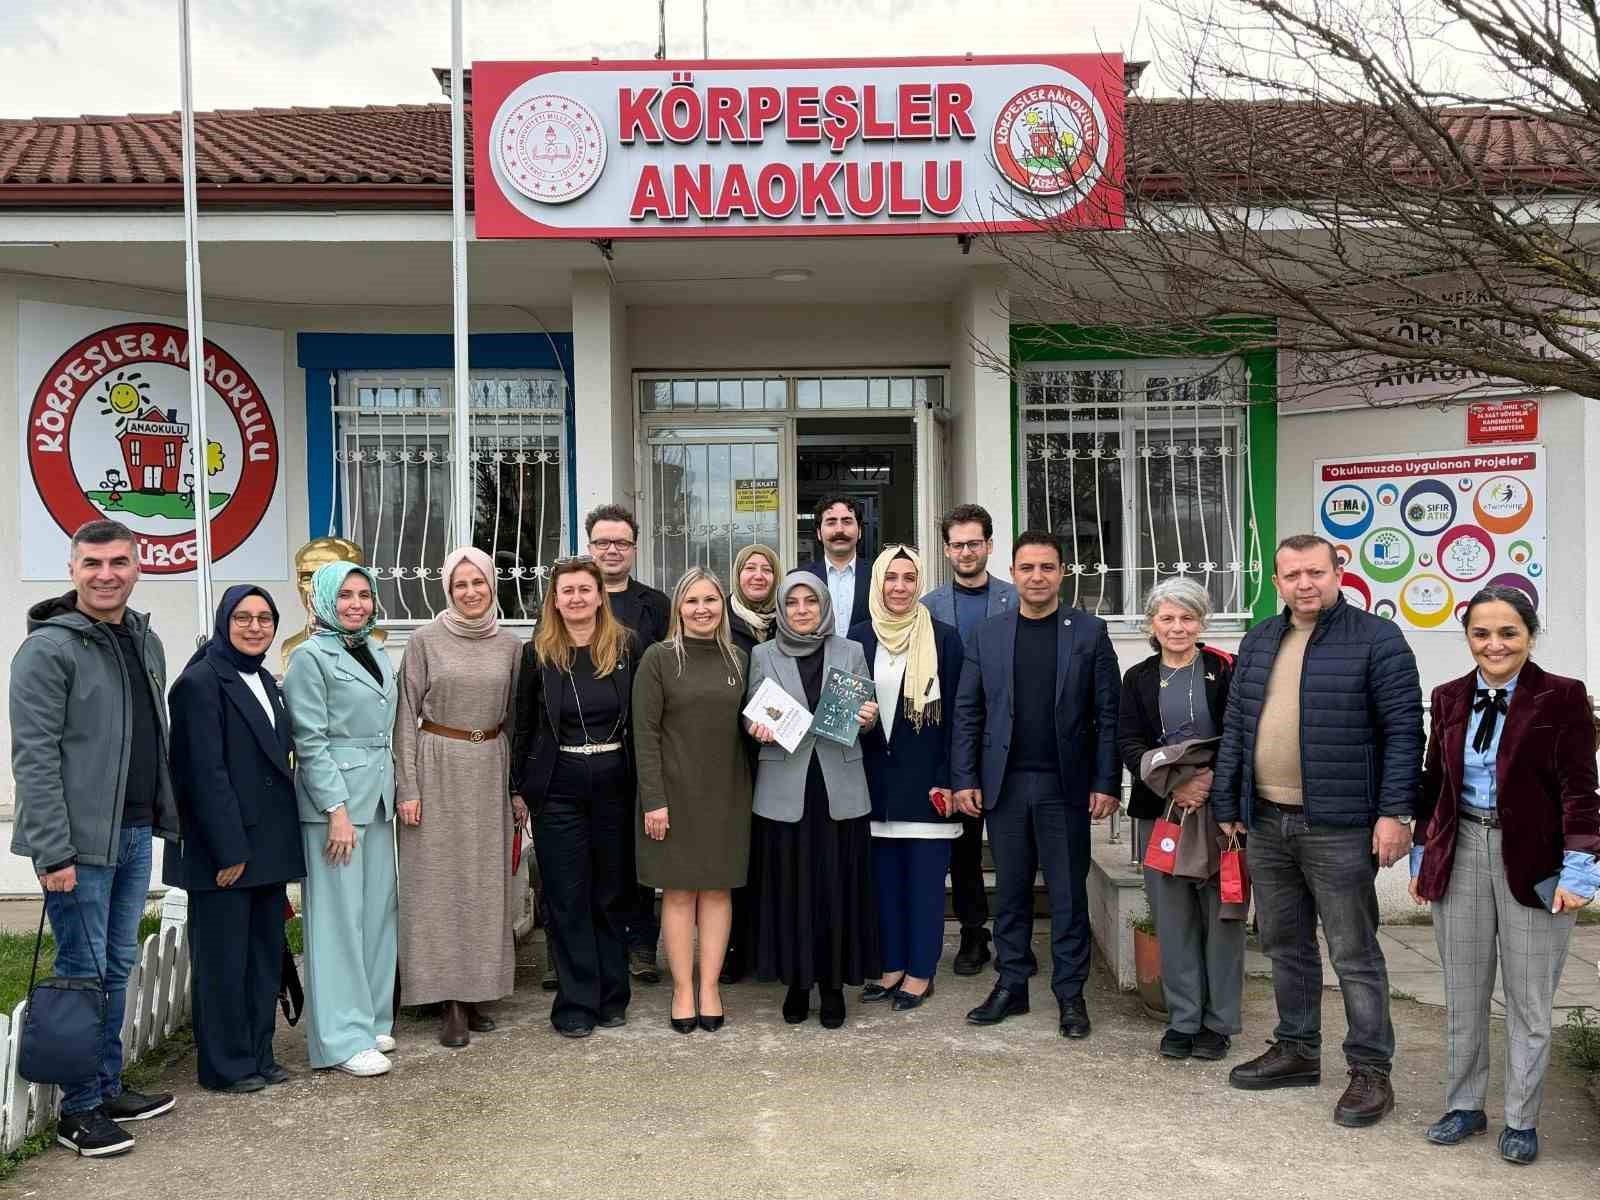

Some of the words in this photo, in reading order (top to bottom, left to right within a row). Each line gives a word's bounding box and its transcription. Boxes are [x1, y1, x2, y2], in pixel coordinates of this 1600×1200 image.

[617, 71, 976, 151] KÖRPEŞLER
[1047, 89, 1096, 140] ANAOKULU
[628, 160, 964, 220] ANAOKULU
[34, 333, 157, 453] KÖRPEŞLER
[129, 423, 185, 434] ANAOKULU
[1405, 459, 1471, 475] Uygulanan
[1332, 499, 1359, 511] TEMA
[1426, 503, 1450, 512] SIFIR
[1426, 512, 1449, 520] ATIK
[137, 538, 199, 567] ÜZCE
